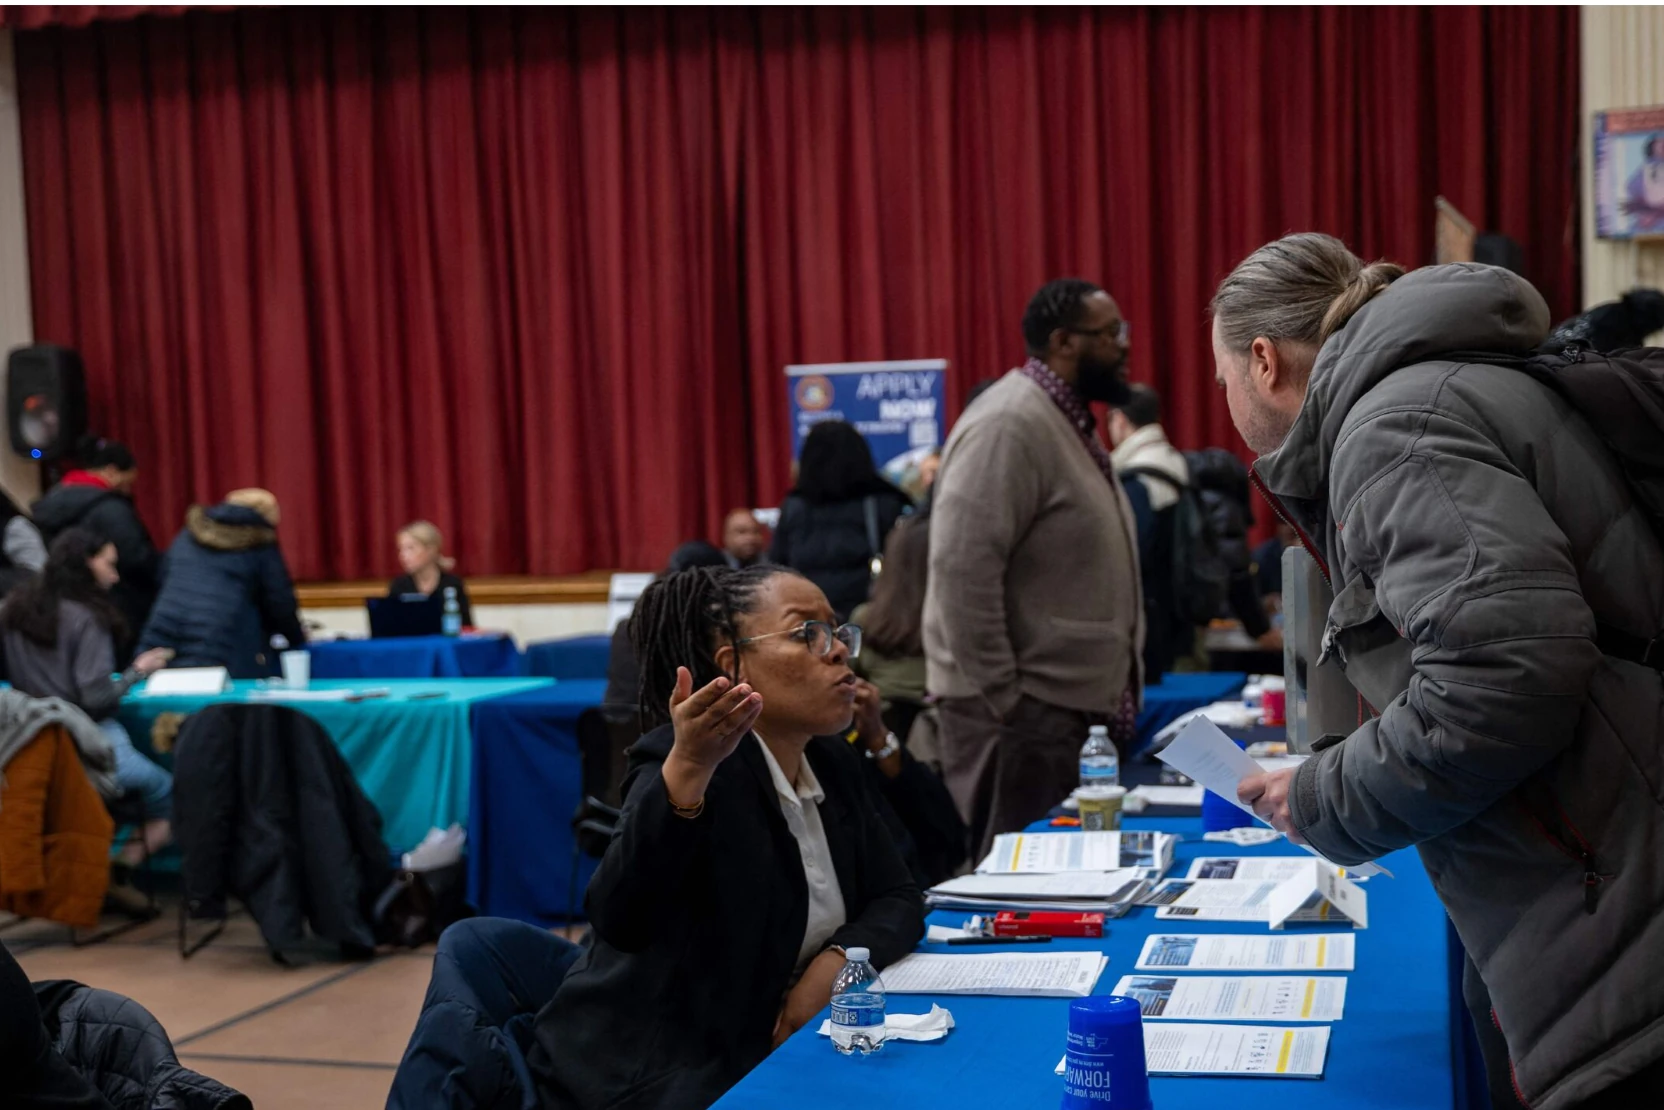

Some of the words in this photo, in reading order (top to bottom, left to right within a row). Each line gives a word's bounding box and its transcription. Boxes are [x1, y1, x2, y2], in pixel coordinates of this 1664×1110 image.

[856, 371, 936, 400] APPLY
[879, 397, 937, 420] NOW
[1073, 1088, 1088, 1099] your
[1090, 1091, 1111, 1101] Drive
